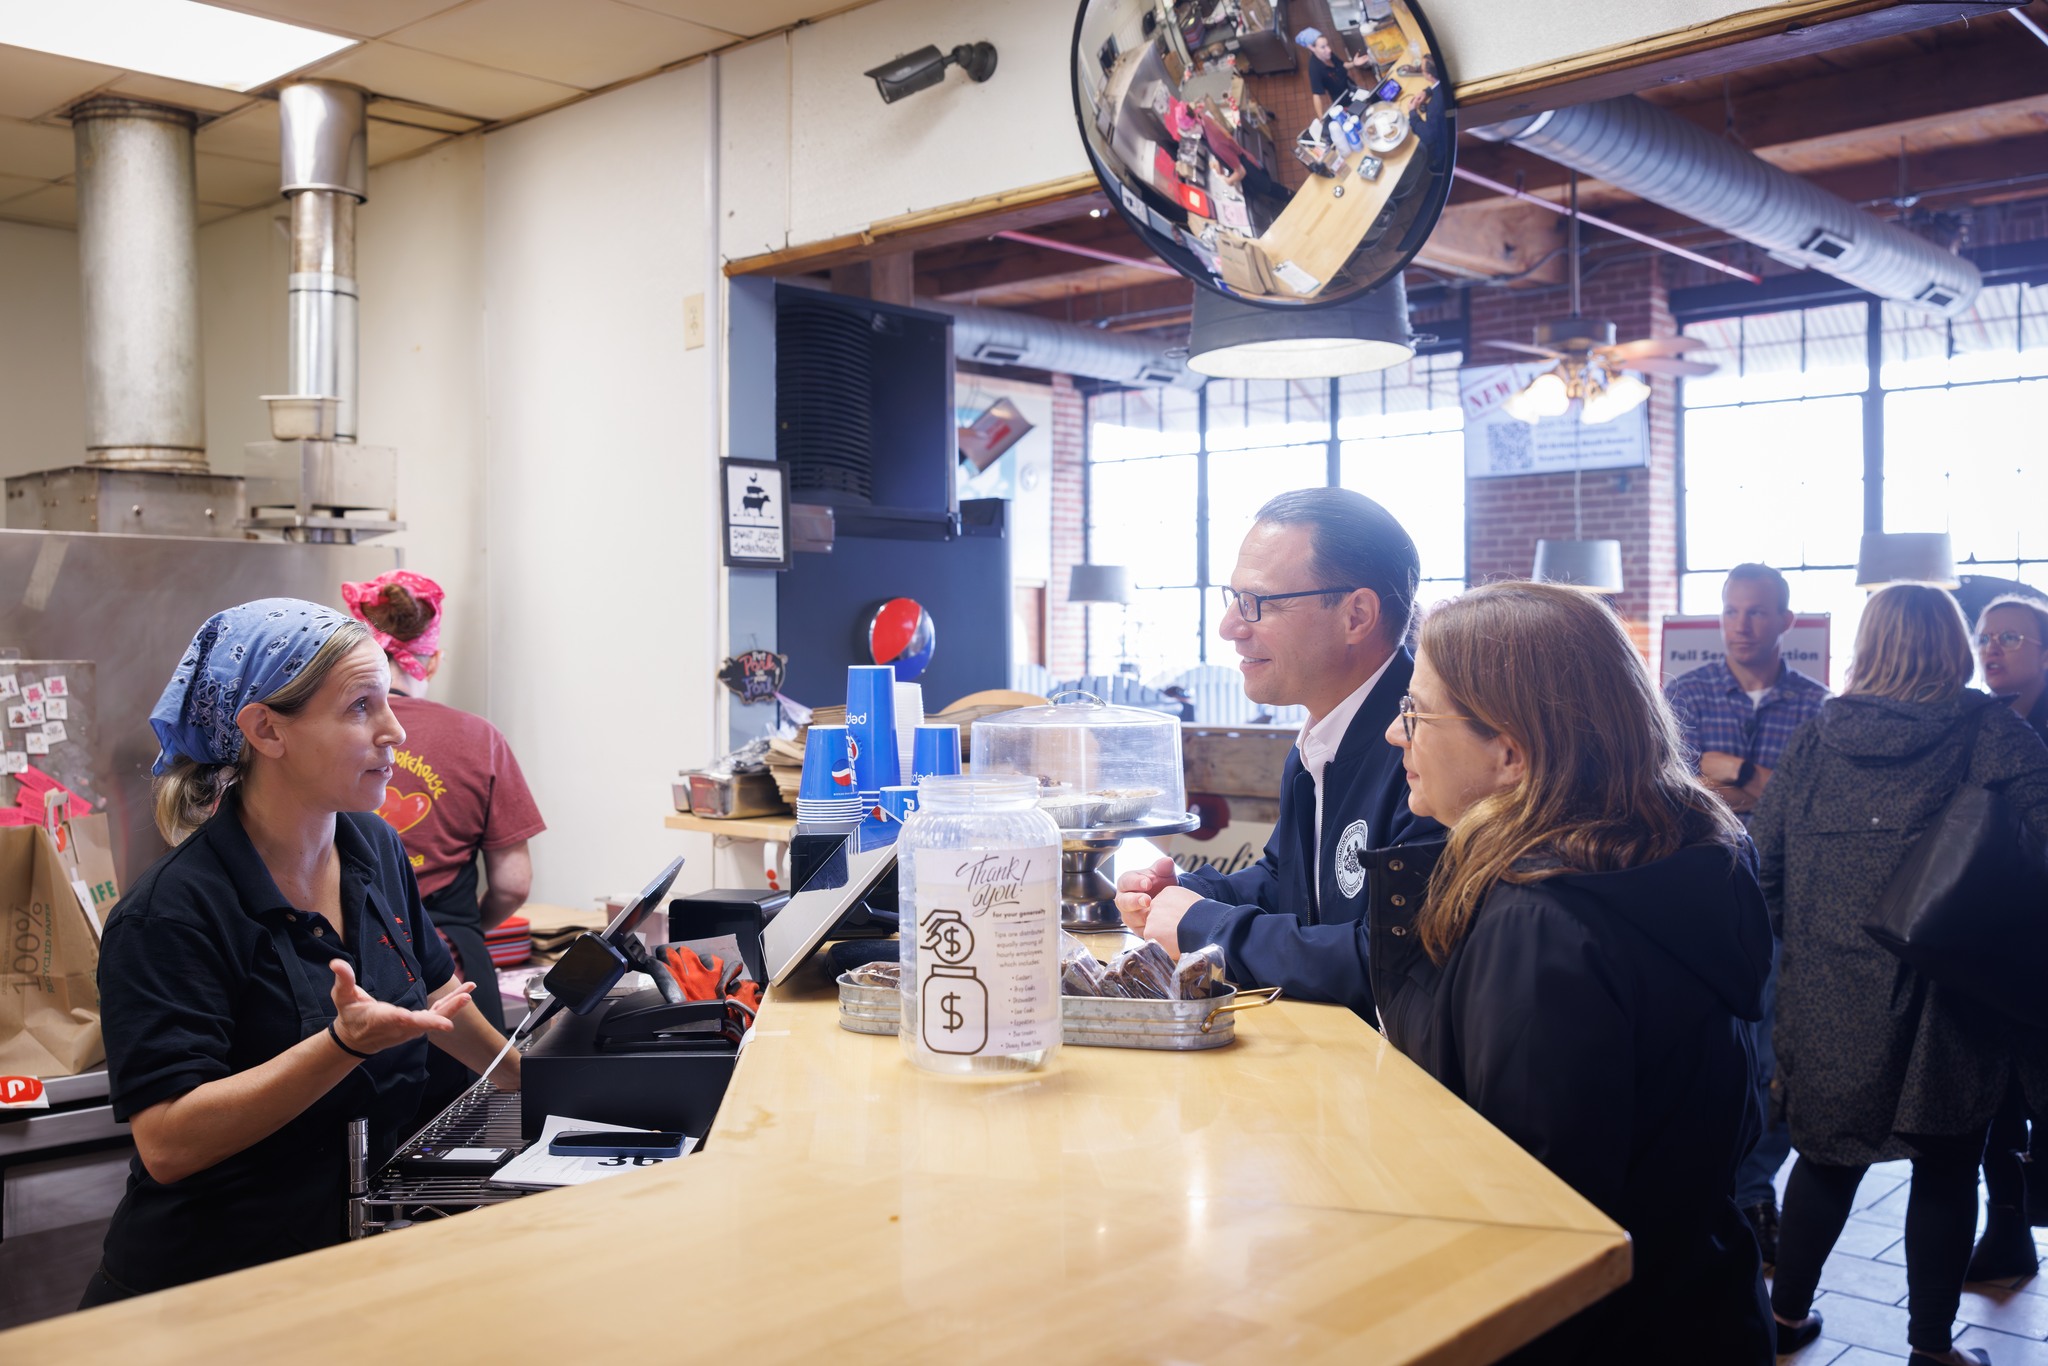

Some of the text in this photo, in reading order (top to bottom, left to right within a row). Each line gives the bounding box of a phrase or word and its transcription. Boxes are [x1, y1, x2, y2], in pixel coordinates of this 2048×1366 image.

[738, 653, 777, 676] Pork
[1670, 649, 1697, 661] Full
[90, 880, 117, 905] IFE
